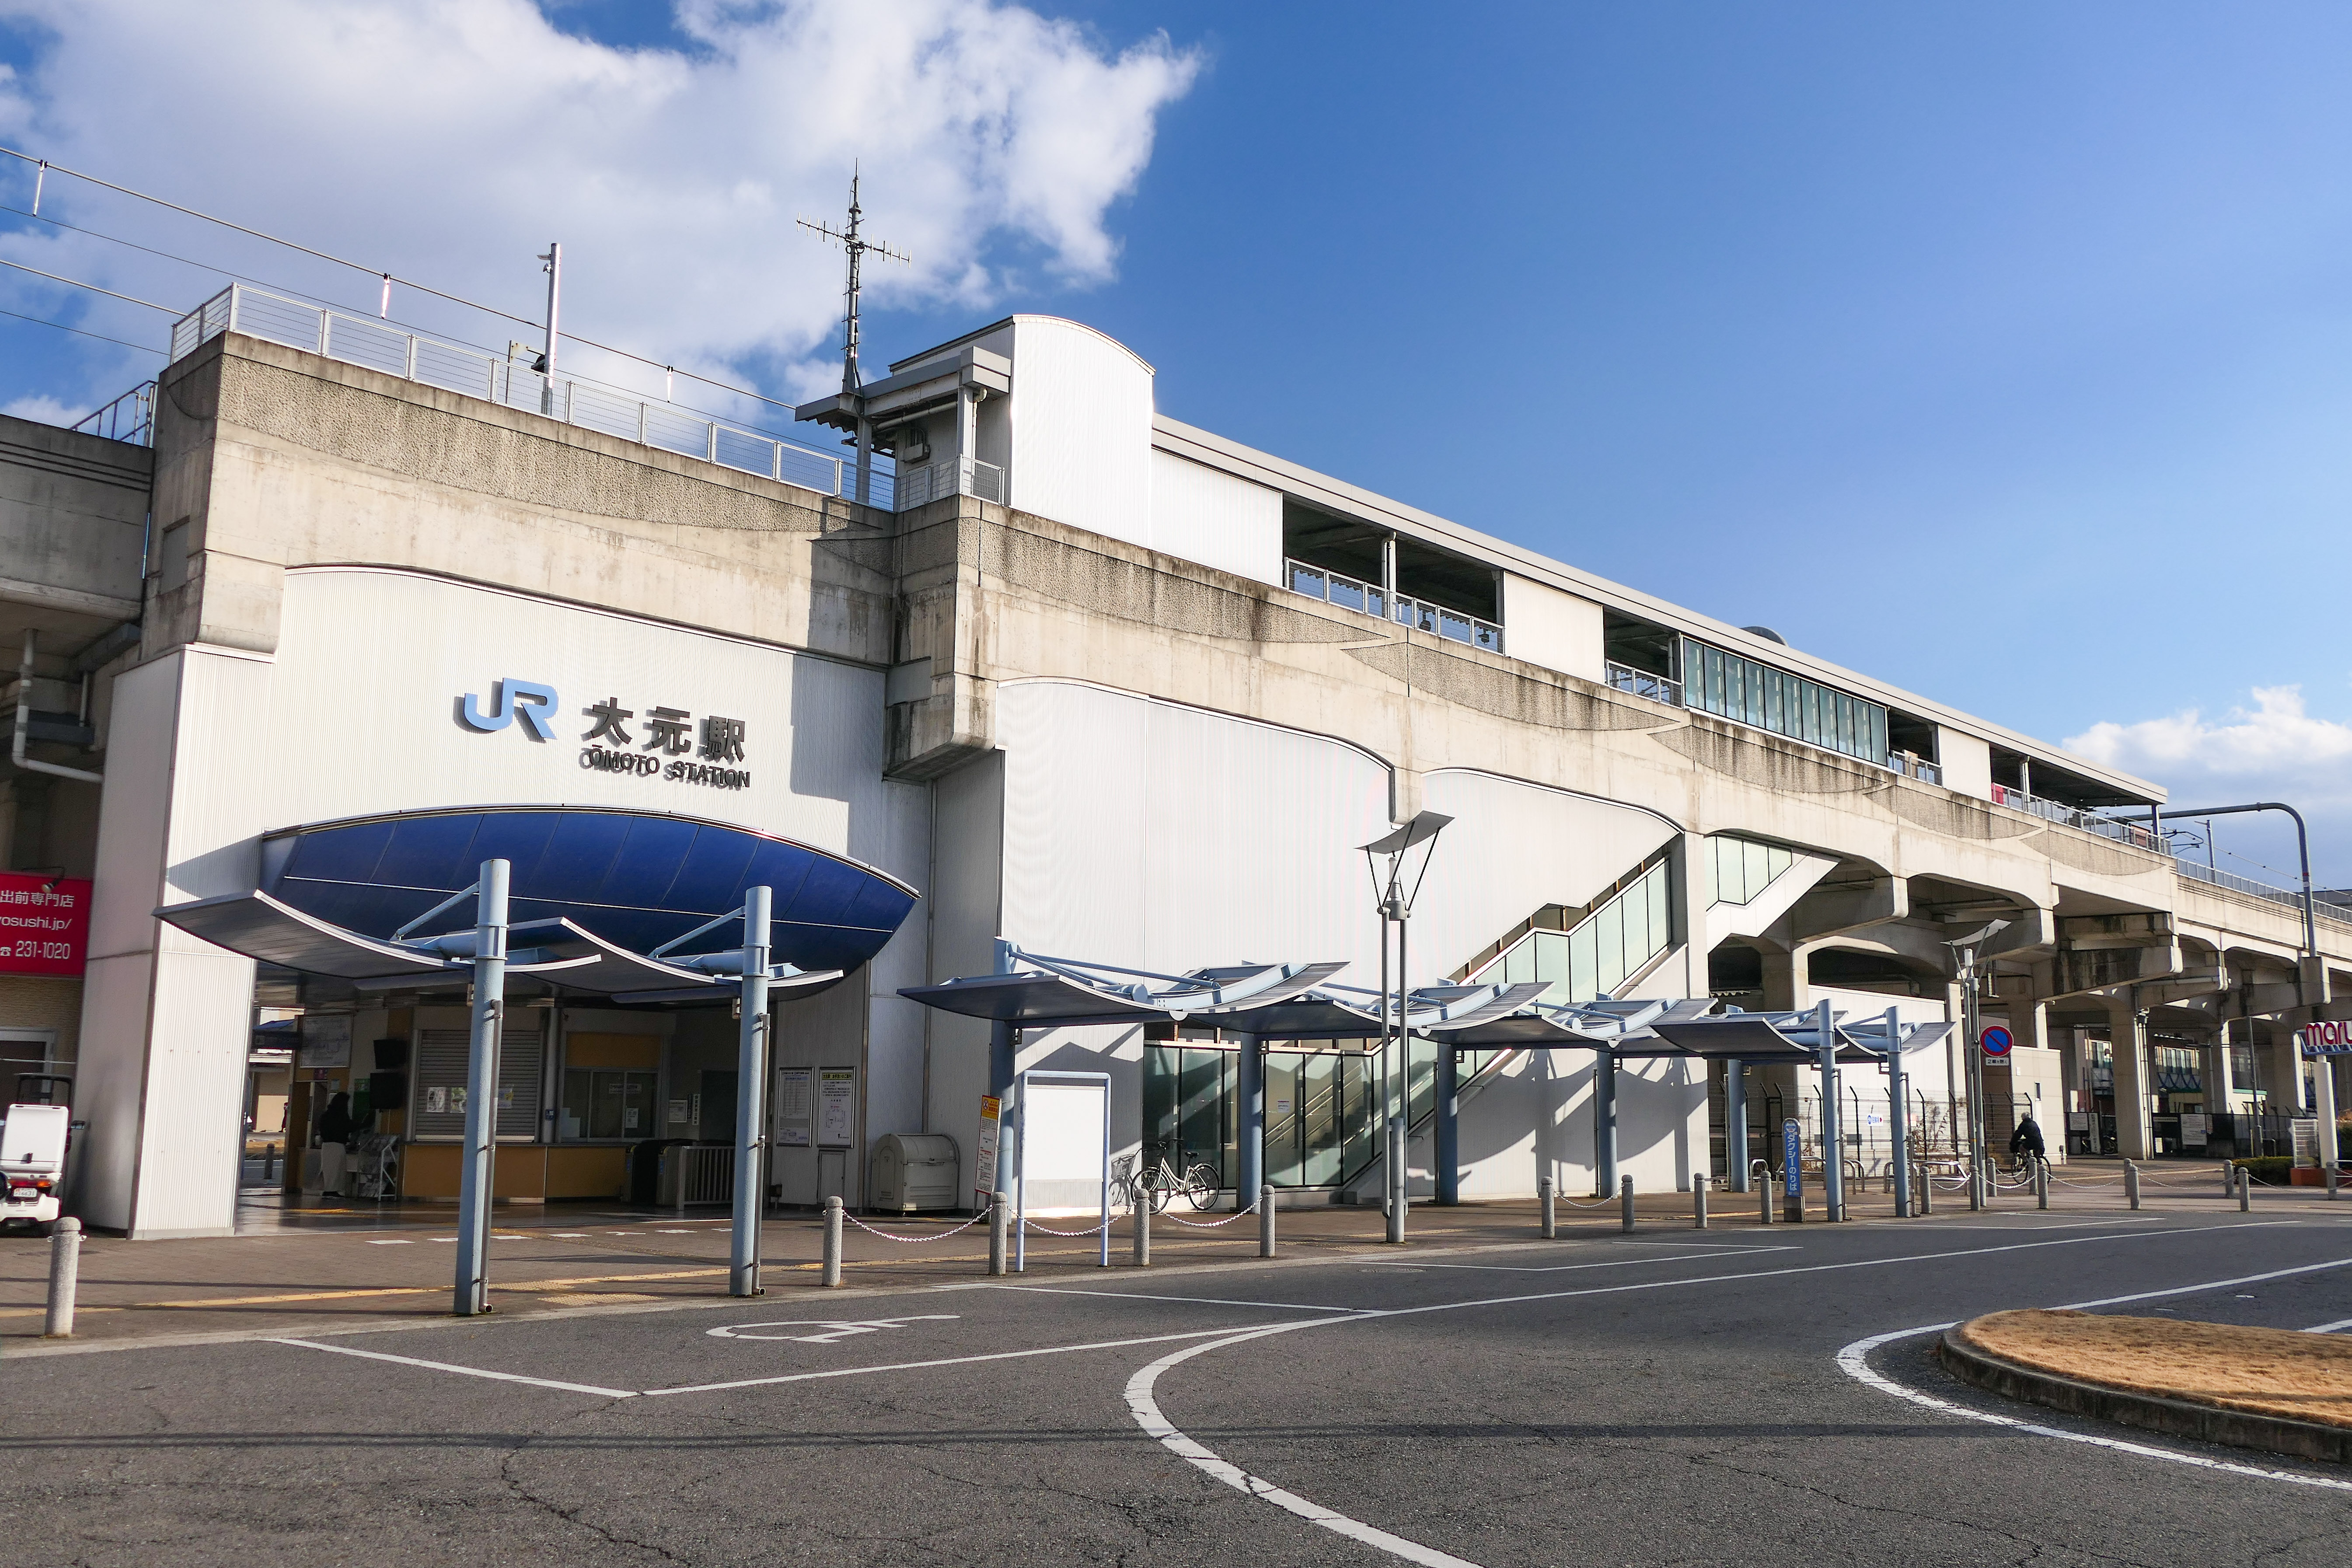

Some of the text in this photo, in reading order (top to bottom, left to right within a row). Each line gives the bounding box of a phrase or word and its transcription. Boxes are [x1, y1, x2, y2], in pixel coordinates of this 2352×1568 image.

[464, 677, 558, 740] JR
[591, 697, 745, 762] 大元駅
[672, 761, 750, 788] STATION
[0, 890, 75, 907] 出前専門店
[15, 940, 71, 960] 231-1020
